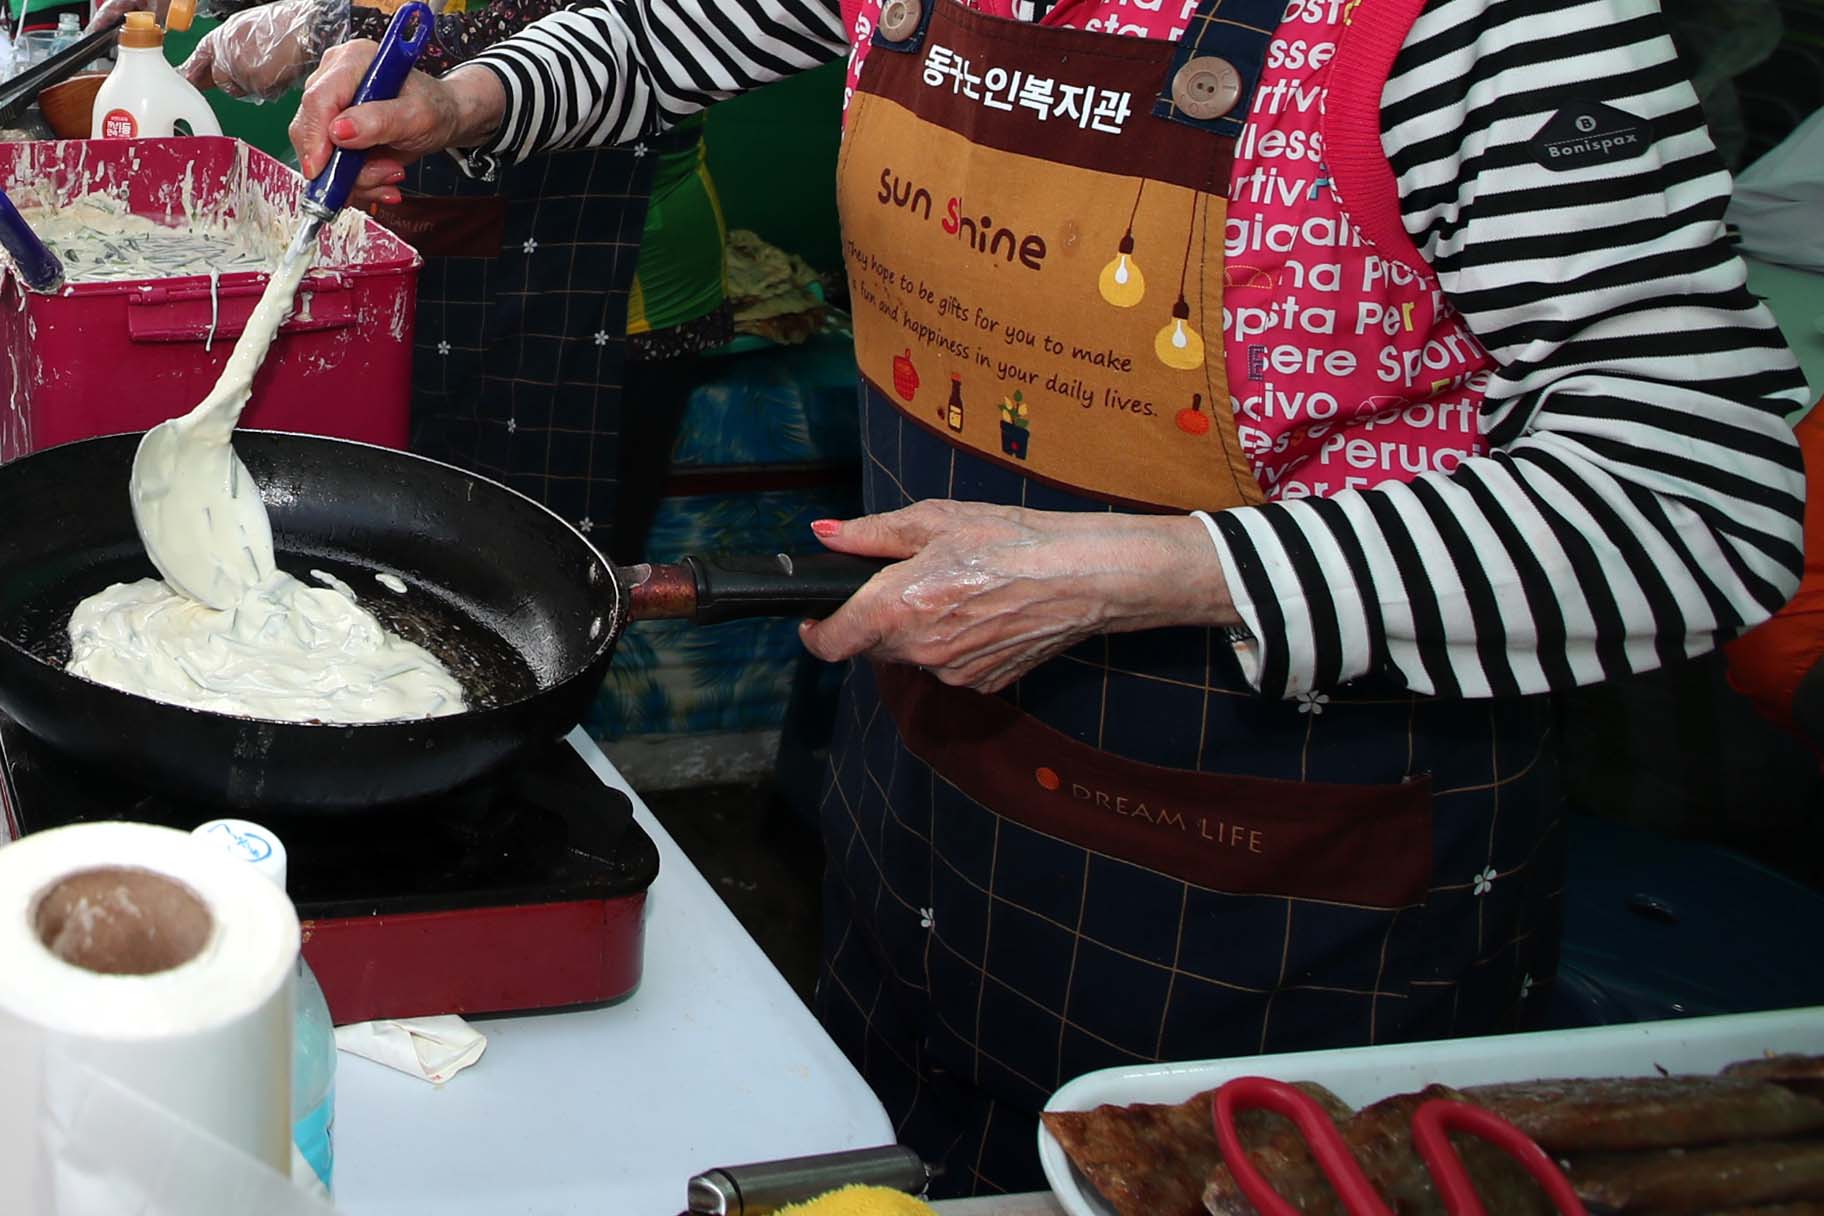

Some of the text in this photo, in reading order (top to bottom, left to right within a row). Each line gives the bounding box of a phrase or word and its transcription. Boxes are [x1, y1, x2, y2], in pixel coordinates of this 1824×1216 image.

[1547, 134, 1638, 158] Bonispax
[848, 241, 1132, 372] They hope to be gifts for you to make
[879, 300, 898, 322] and
[903, 311, 969, 360] happiness
[976, 346, 991, 368] in
[997, 361, 1039, 381] your
[1046, 373, 1094, 409] daily
[1104, 387, 1158, 417] lives.
[1072, 782, 1265, 854] DREAM LIFE
